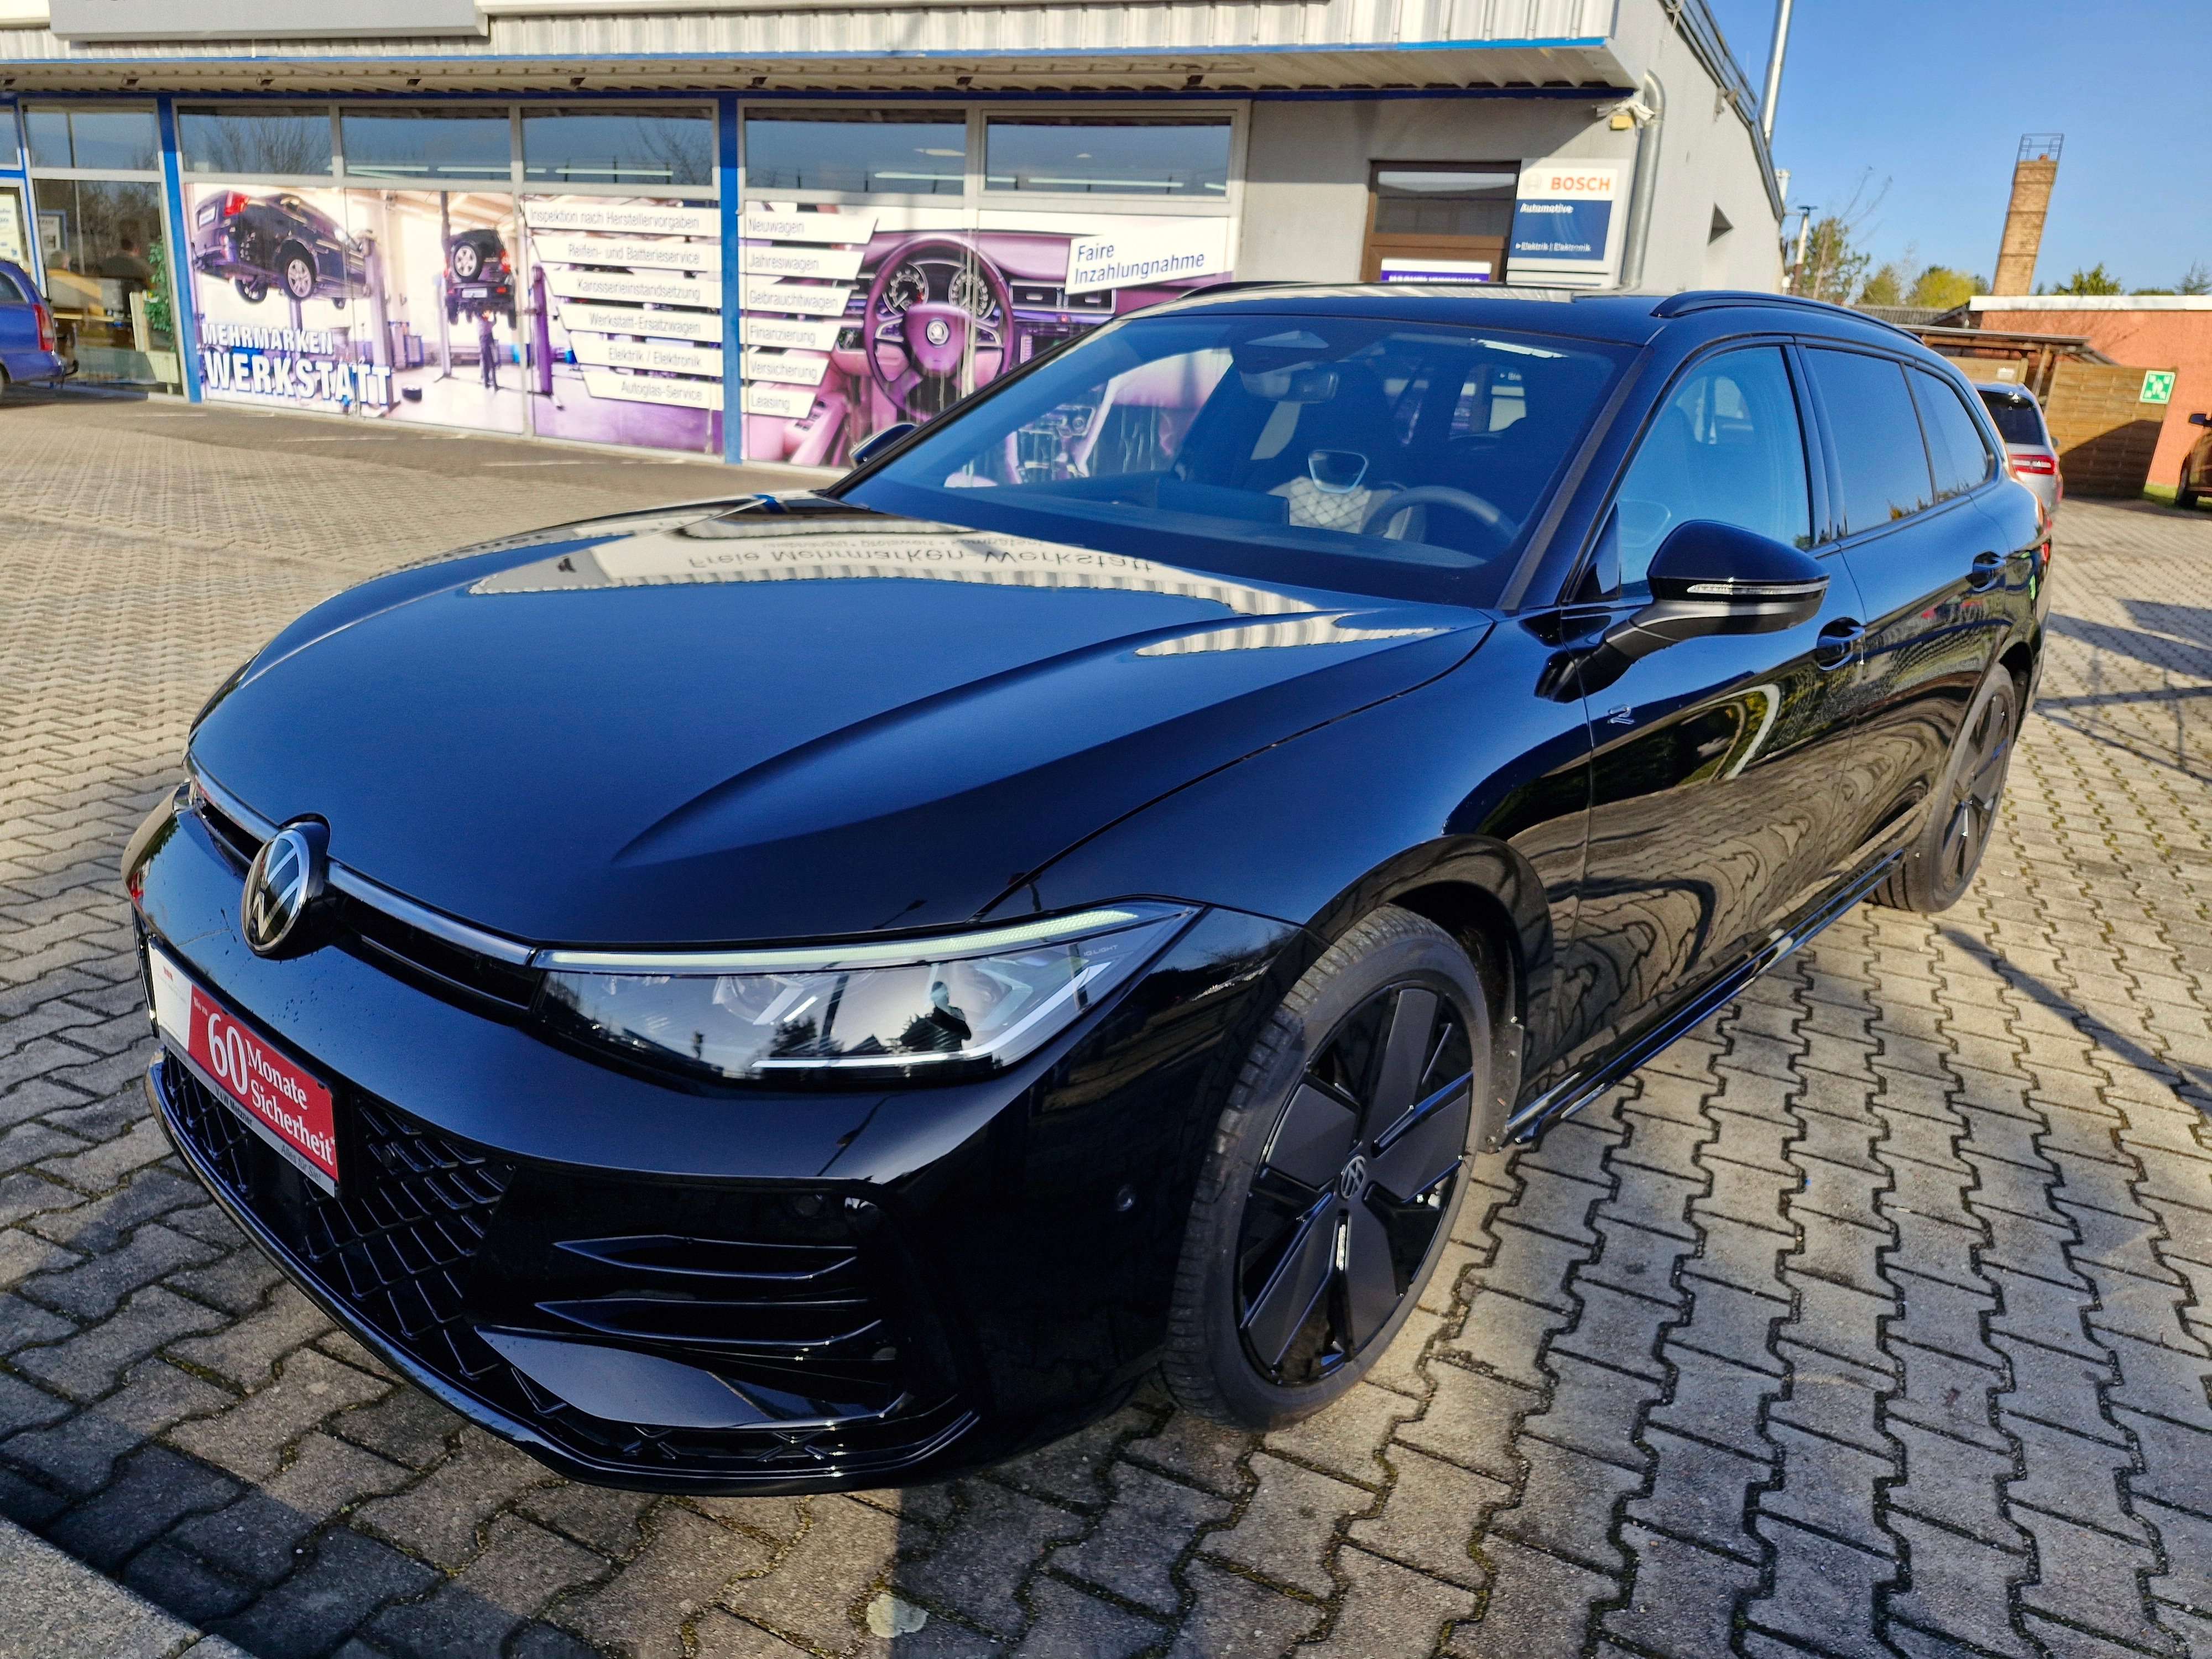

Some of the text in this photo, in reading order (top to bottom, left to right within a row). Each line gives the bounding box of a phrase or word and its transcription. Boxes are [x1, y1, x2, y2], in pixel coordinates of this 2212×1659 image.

[1551, 176, 1611, 191] BOSCH
[1520, 203, 1574, 213] Automotive
[530, 208, 700, 231] Inspektion nach Herstellervorgaben
[748, 218, 805, 236] Neuwagen
[568, 243, 700, 264] Reifen- und Batterieservice
[748, 253, 819, 272] Jahreswagen
[1077, 243, 1115, 263] Faire
[1074, 253, 1205, 285] Inzahlungnahme
[577, 278, 701, 302] Karosserieinstandsetzung
[749, 289, 838, 310] Gebrauchtwagen
[589, 312, 701, 335] Werkstatt-Ersatzwagen
[201, 323, 333, 355] MEHRMARKEN
[749, 325, 816, 346] Finanzierung
[608, 347, 644, 363] Elektrik
[654, 350, 702, 368] Elektronik
[204, 351, 390, 405] WERKSTATT
[749, 359, 818, 379] Versicherung
[620, 380, 703, 401] Autoglas-Service
[750, 393, 790, 411] Leasing
[207, 1013, 248, 1095] 60
[246, 1039, 308, 1110] Monate
